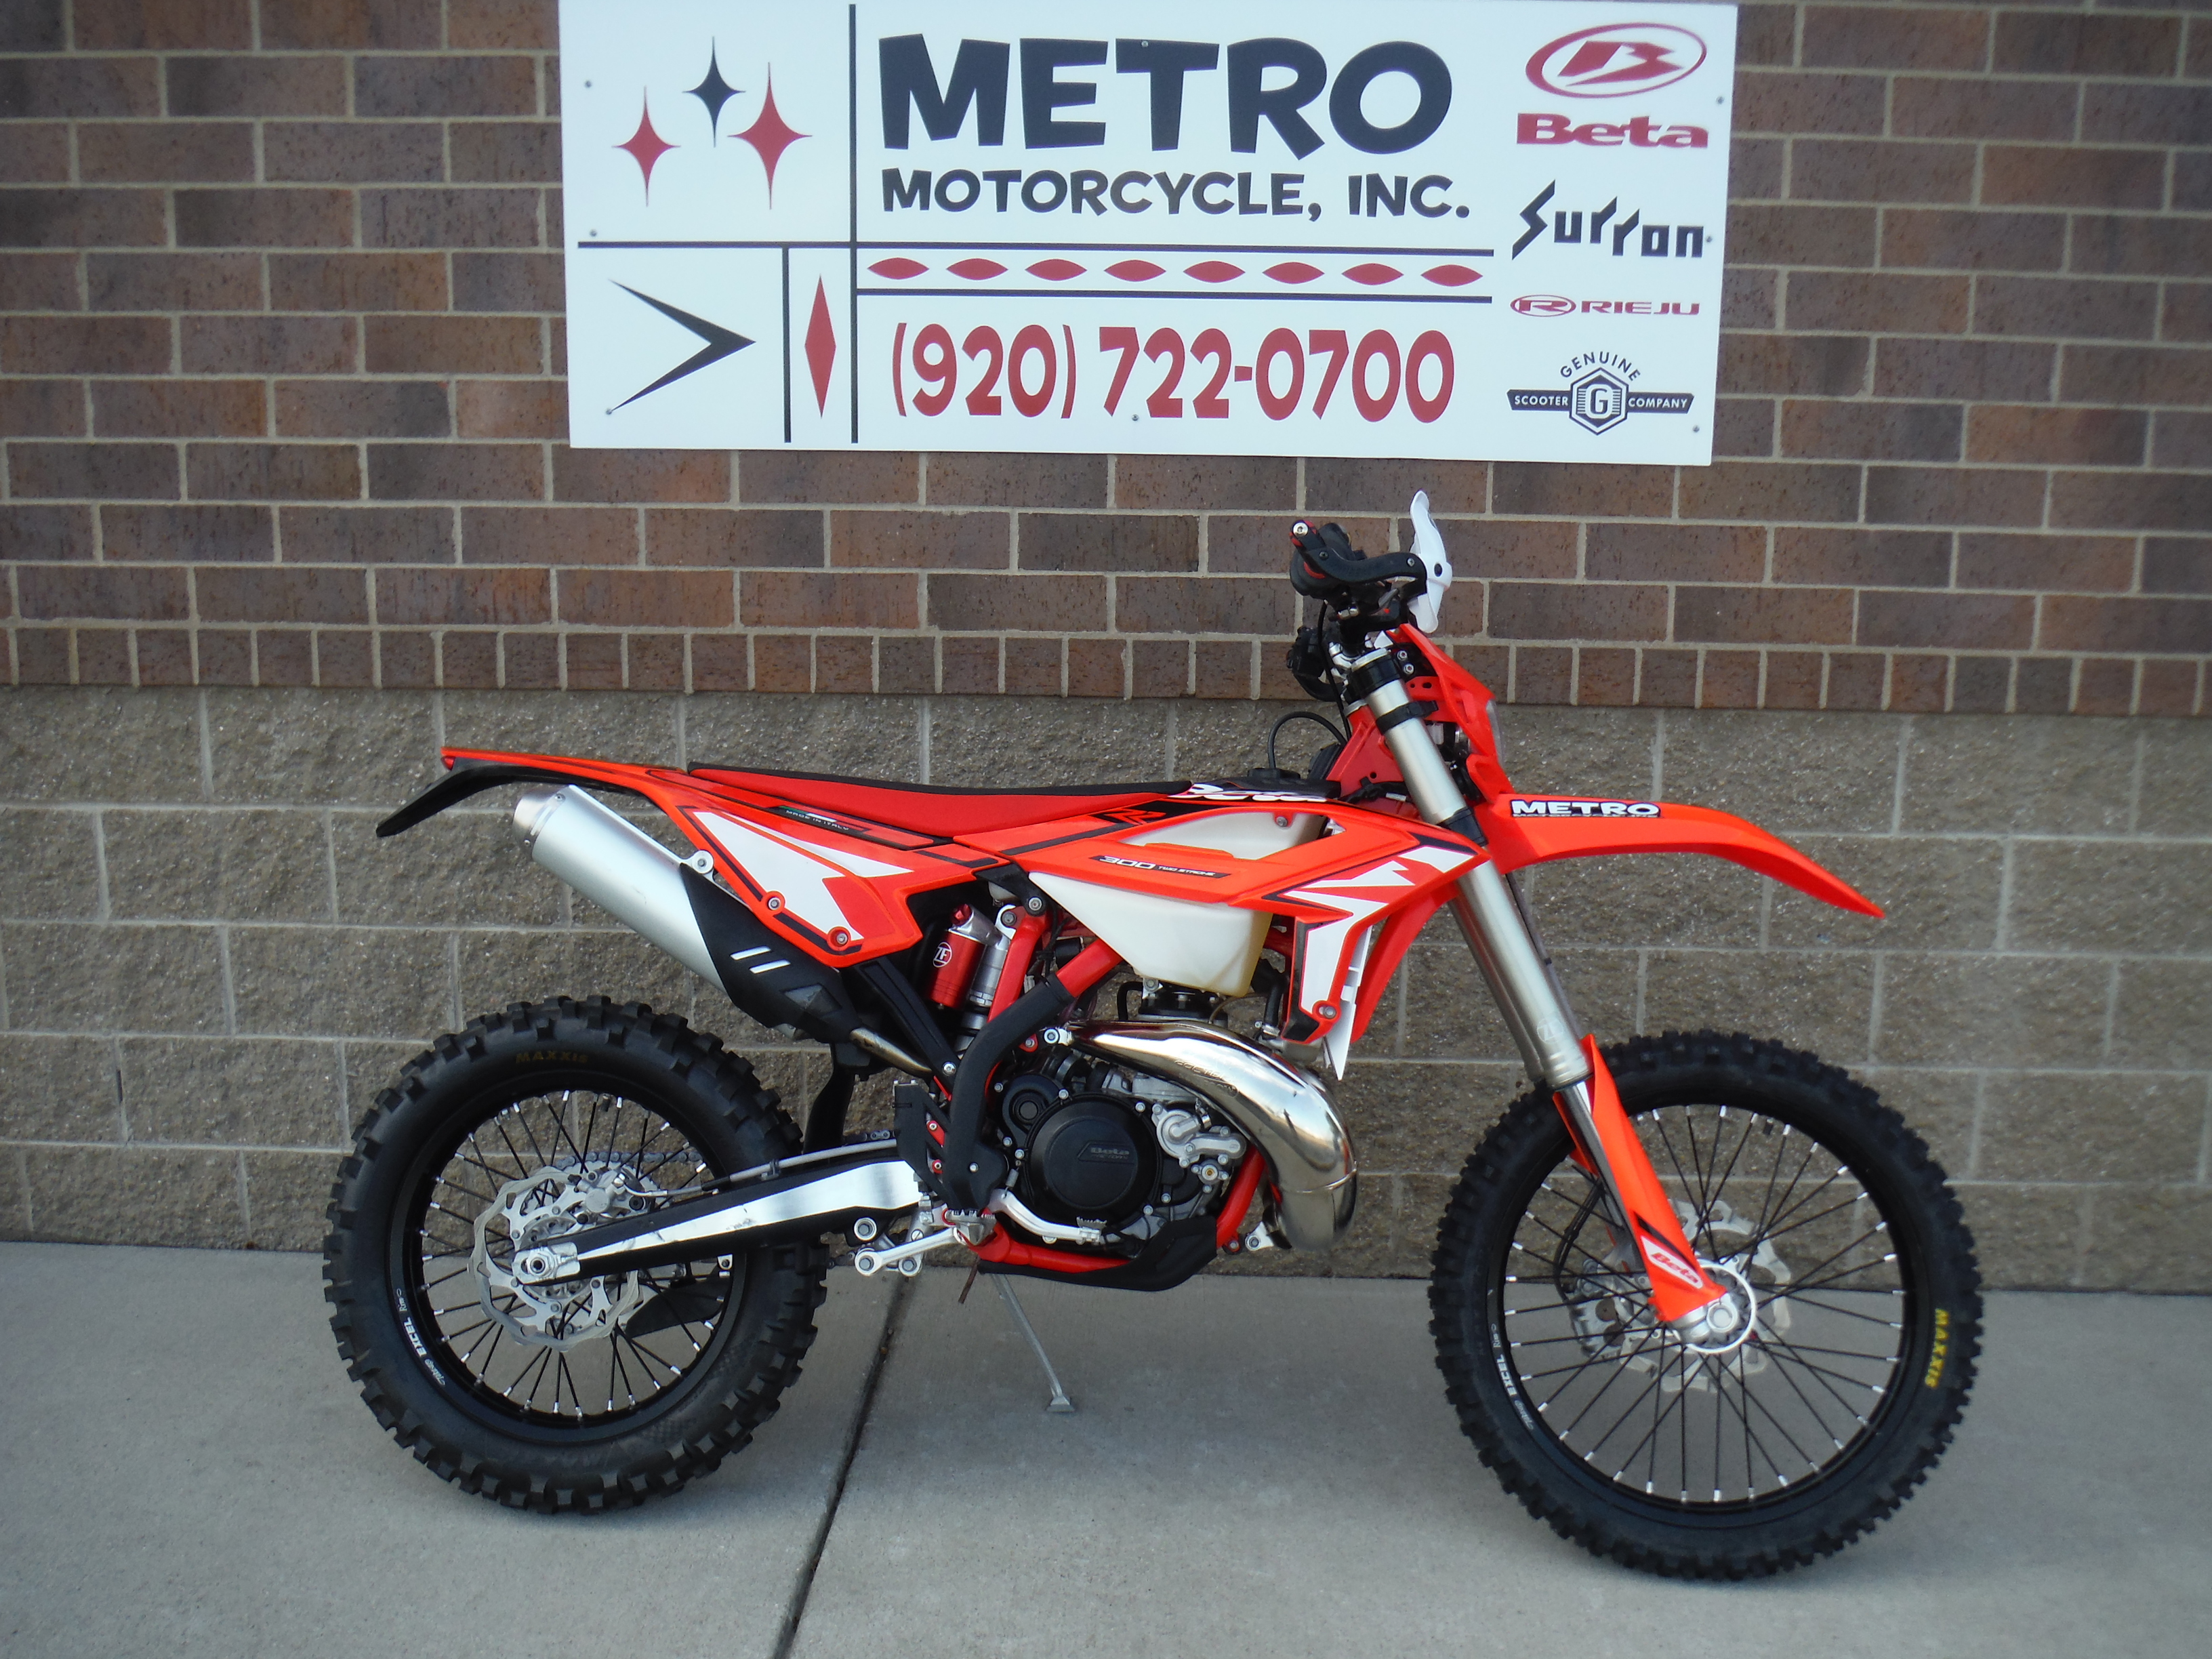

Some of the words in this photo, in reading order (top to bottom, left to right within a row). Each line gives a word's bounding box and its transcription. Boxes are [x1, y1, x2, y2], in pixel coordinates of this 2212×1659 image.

[879, 33, 1452, 161] METRO
[1517, 112, 1708, 148] Beta
[881, 167, 1322, 222] MOTORCYCLE,
[1347, 173, 1471, 218] INC.
[1581, 300, 1700, 316] RIEJU
[892, 322, 1076, 419] (920)
[1099, 325, 1455, 424] 722-0700
[1560, 351, 1641, 382] GENUINE
[1514, 395, 1569, 406] SCOOTER
[1628, 397, 1688, 409] COMPANY
[1511, 800, 1660, 815] METRO
[1099, 855, 1156, 869] 300
[404, 1317, 428, 1357] EXCEL
